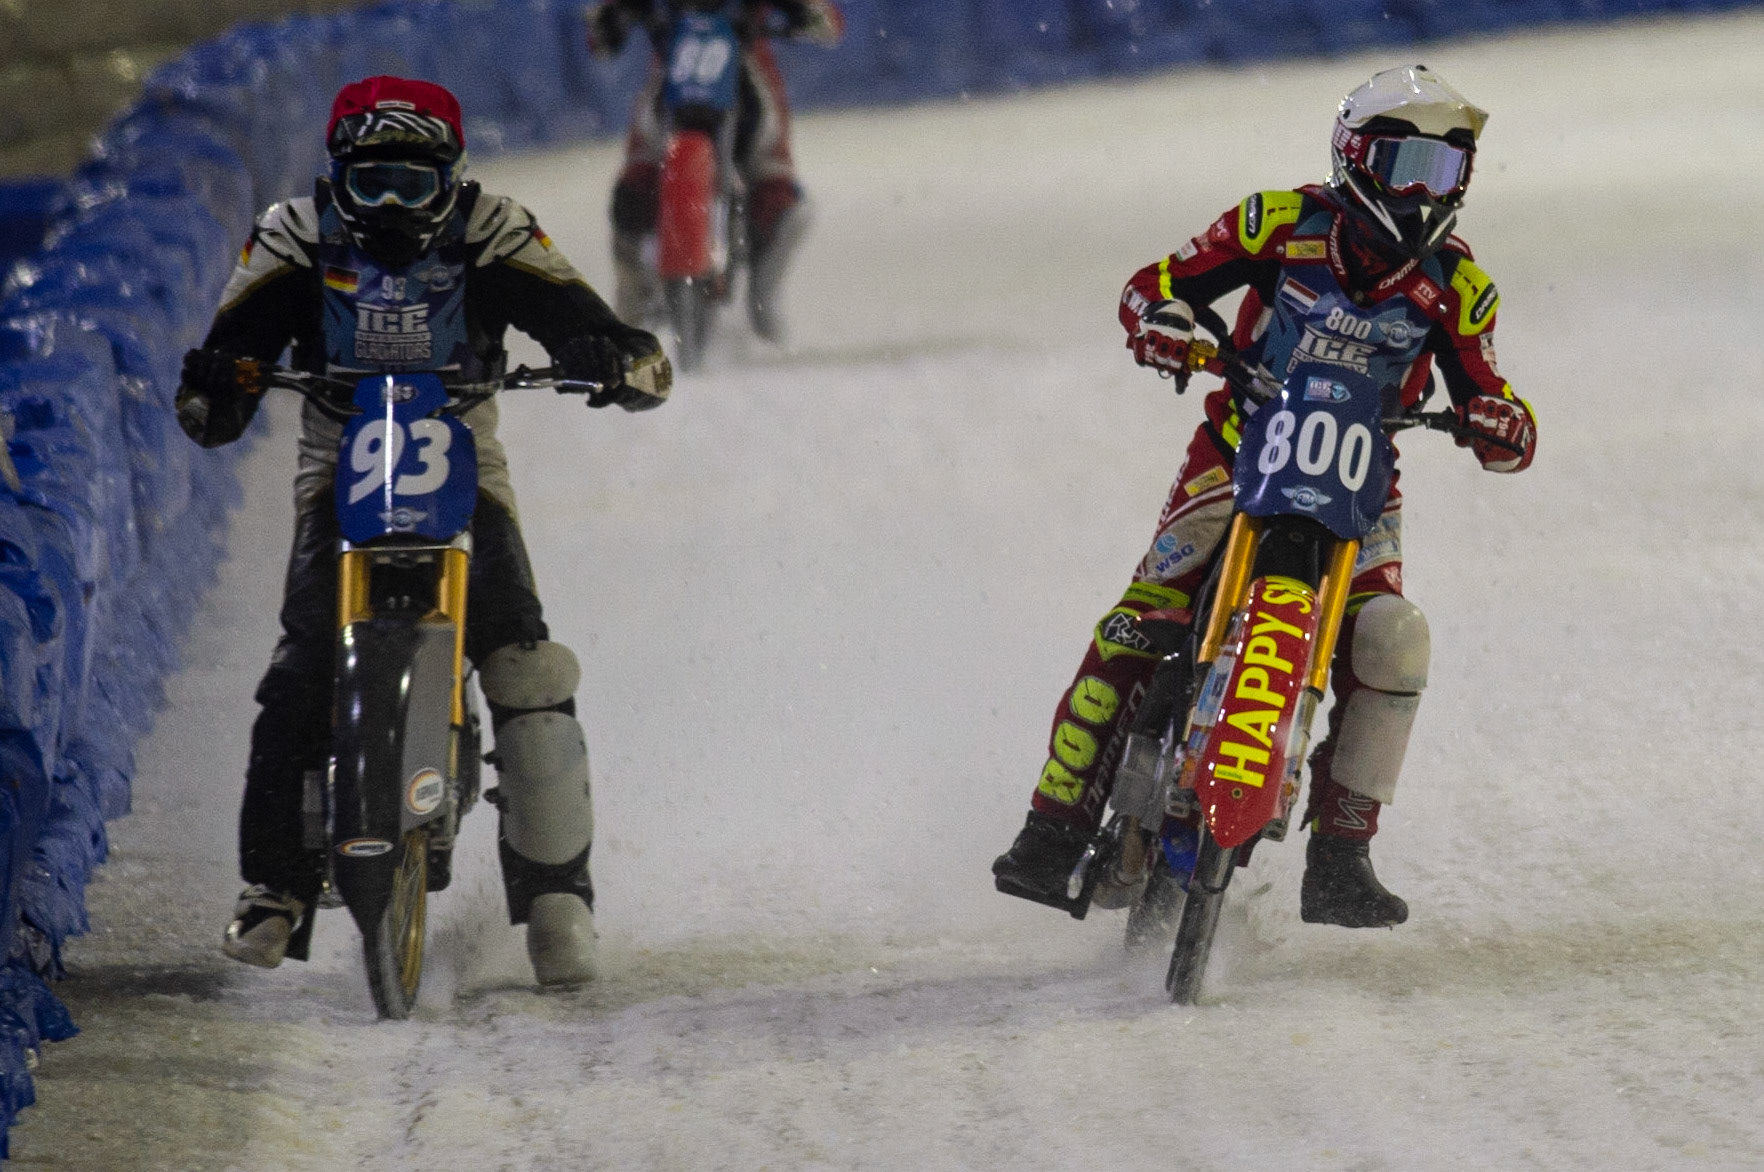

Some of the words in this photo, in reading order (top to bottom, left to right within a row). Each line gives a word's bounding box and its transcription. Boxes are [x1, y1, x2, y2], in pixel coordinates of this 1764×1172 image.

[382, 275, 407, 301] 93
[356, 306, 430, 333] ICE
[1325, 306, 1372, 340] 800
[1298, 326, 1377, 366] ICE
[348, 418, 453, 506] 93
[1257, 409, 1373, 492] 800
[1155, 543, 1195, 573] WSG
[1212, 610, 1305, 788] HAPPY
